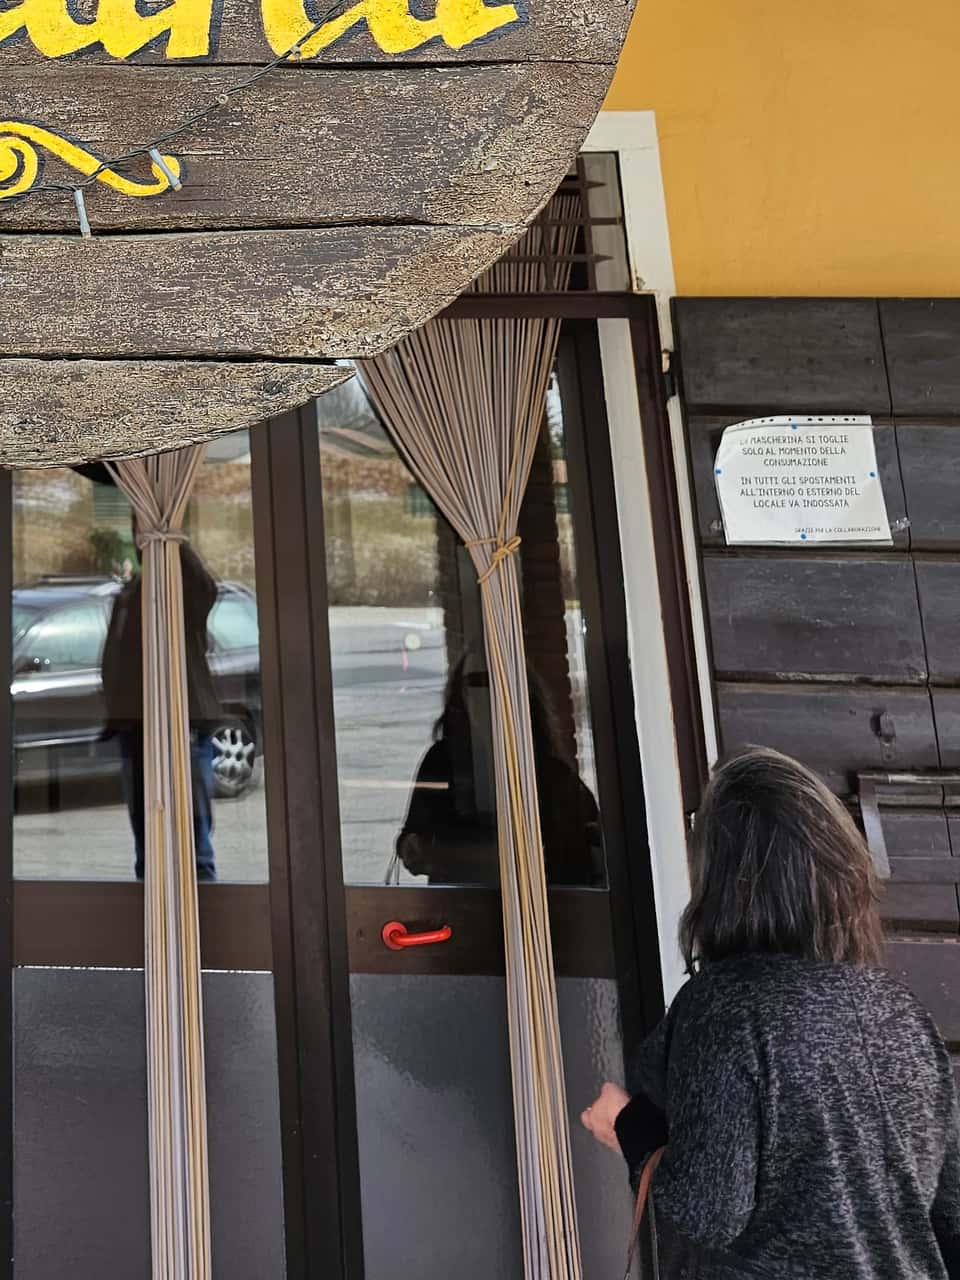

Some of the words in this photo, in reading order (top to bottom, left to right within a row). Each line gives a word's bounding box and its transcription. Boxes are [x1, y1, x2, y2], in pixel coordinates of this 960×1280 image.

[750, 435, 803, 445] MASCHERINA
[805, 435, 815, 444] SI
[818, 434, 849, 444] TOGLIE
[742, 447, 764, 456] SOLO
[765, 447, 776, 456] AL
[778, 447, 818, 456] MOMENTO
[820, 446, 846, 455] DELLA
[763, 458, 828, 467] CONSUMAZIONE
[740, 476, 752, 485] IN
[754, 476, 779, 485] TUTTI
[781, 476, 796, 485] GLI
[798, 476, 856, 485] SPOSTAMENTI
[798, 488, 804, 497] O
[806, 488, 842, 497] ESTERNO
[753, 499, 786, 508] LOCALE
[788, 499, 800, 508] VA
[802, 499, 849, 508] INDOSSATA
